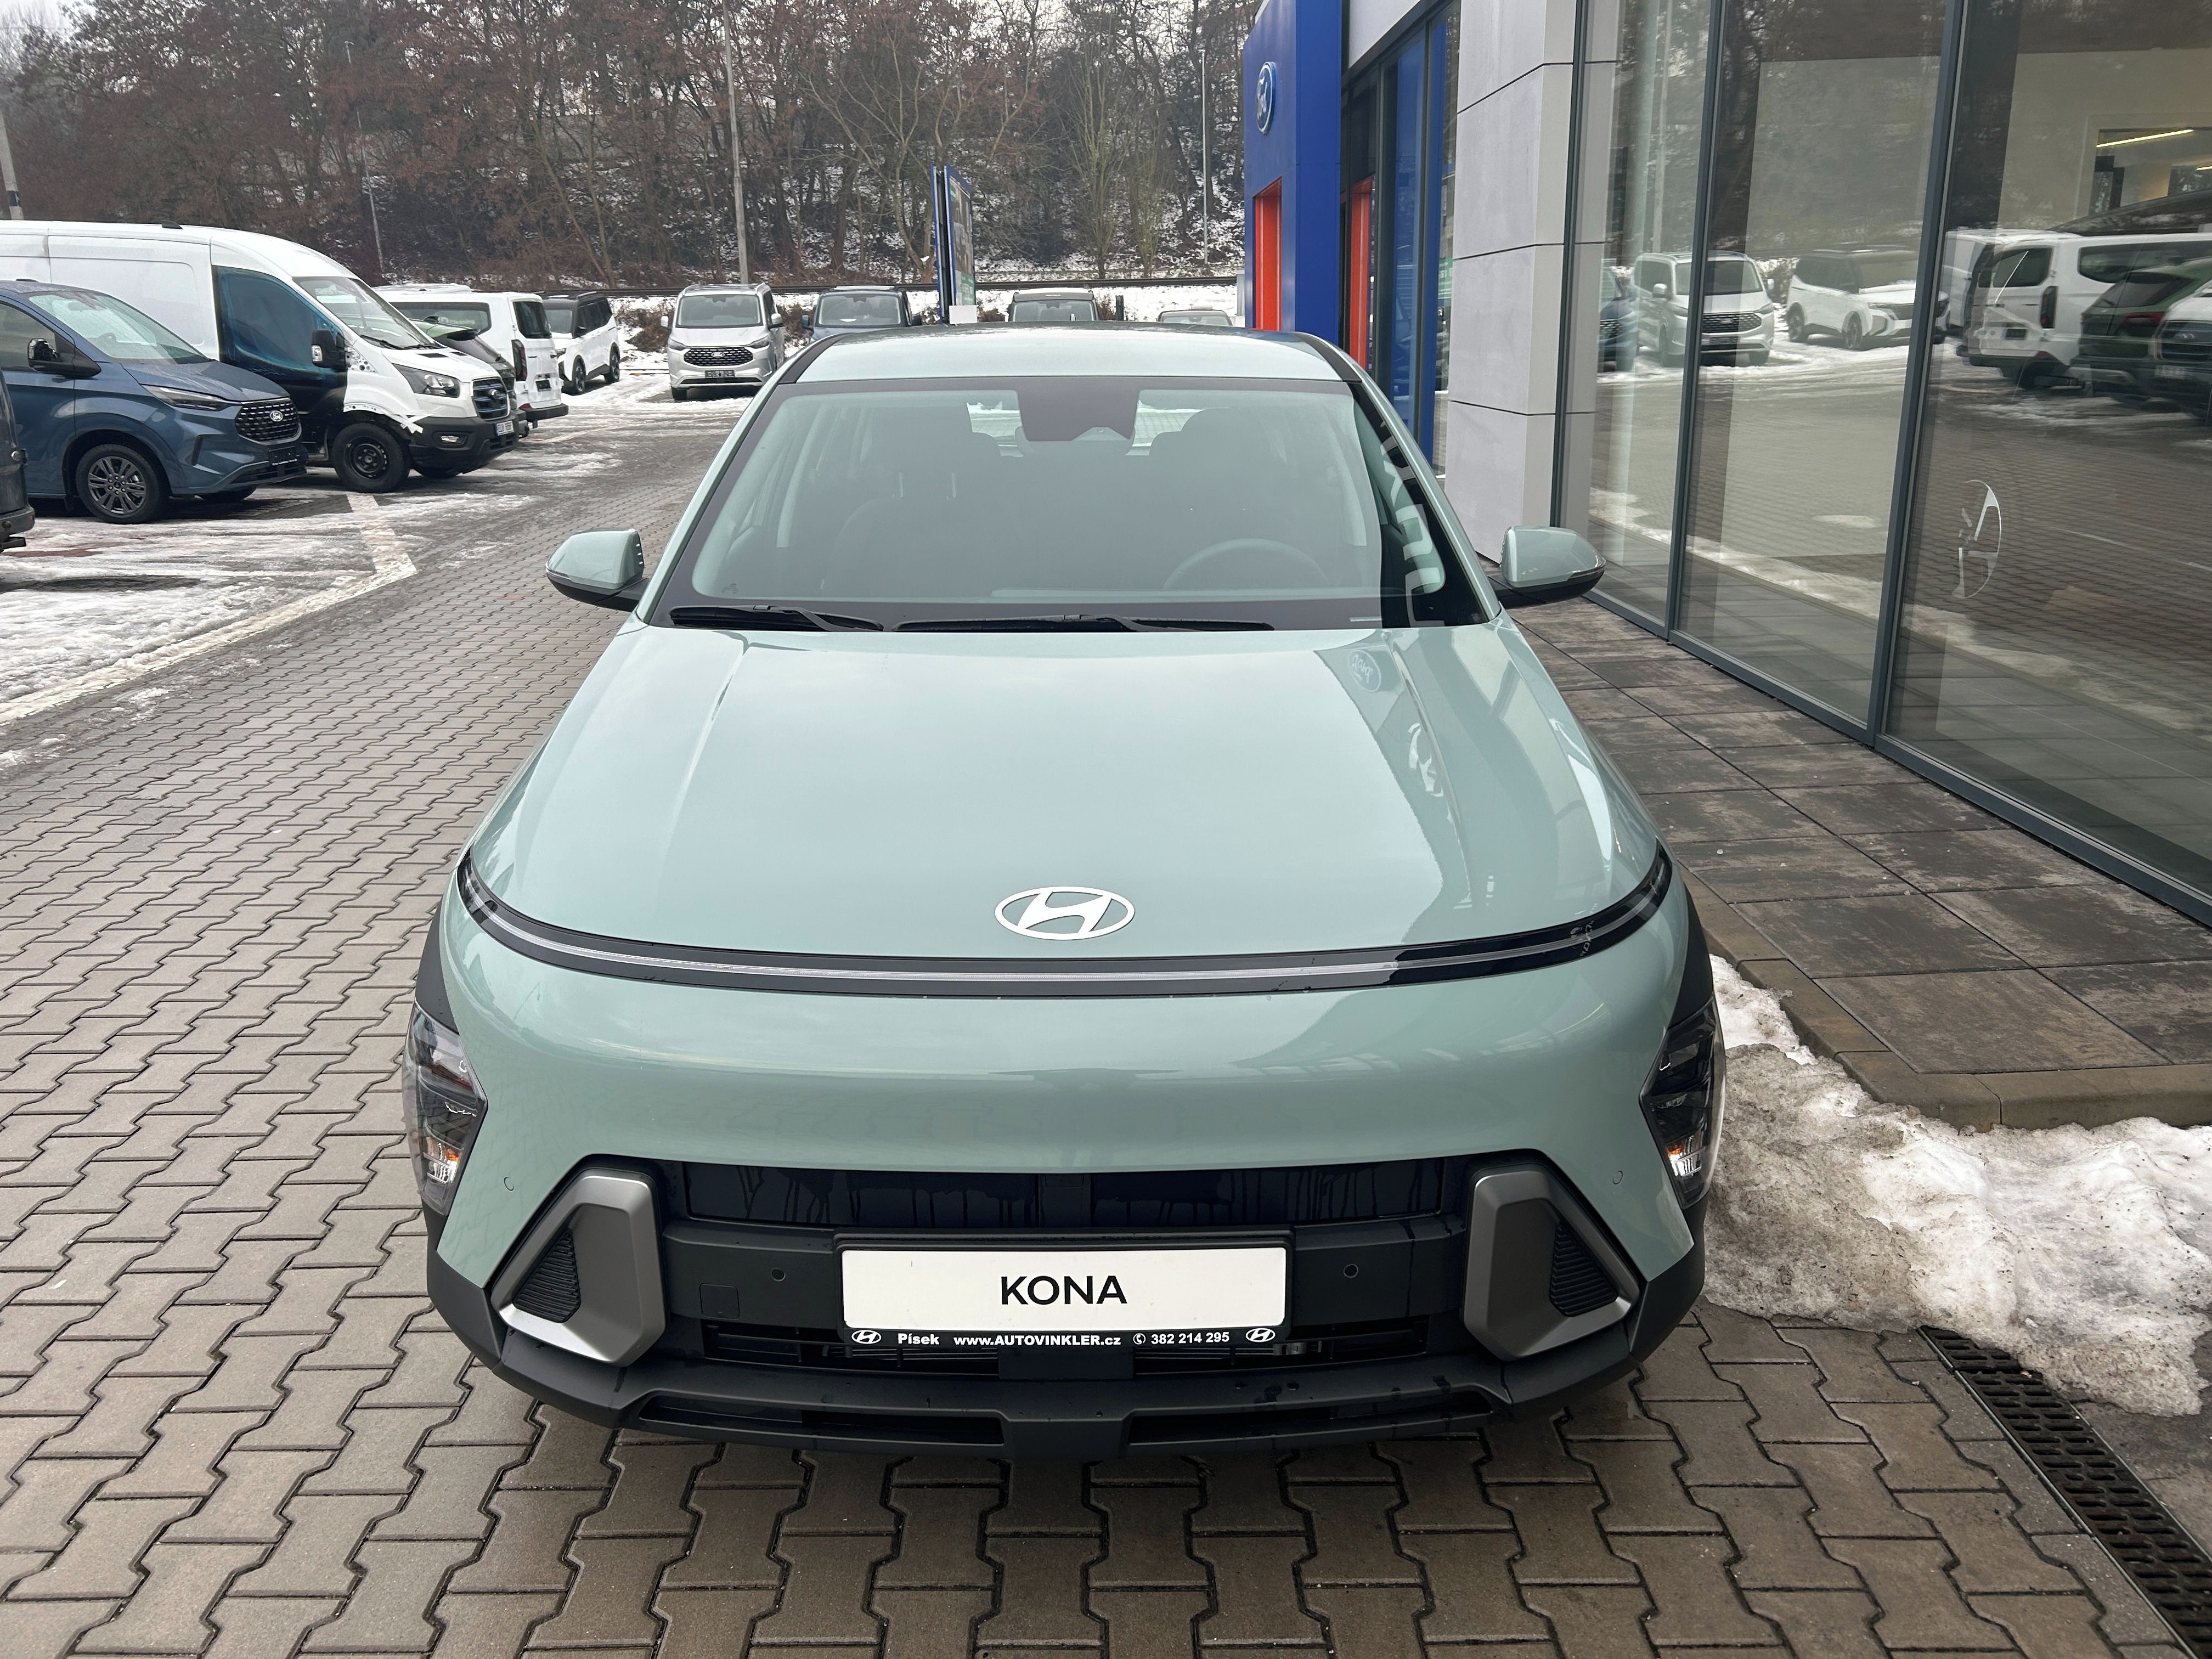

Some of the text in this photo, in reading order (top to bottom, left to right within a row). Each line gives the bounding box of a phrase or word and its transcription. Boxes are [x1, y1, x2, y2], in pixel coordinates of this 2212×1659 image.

[1001, 1275, 1128, 1305] KONA
[898, 1331, 1229, 1346] Písek www.AUTOVINKLER.cz 382 214 295
